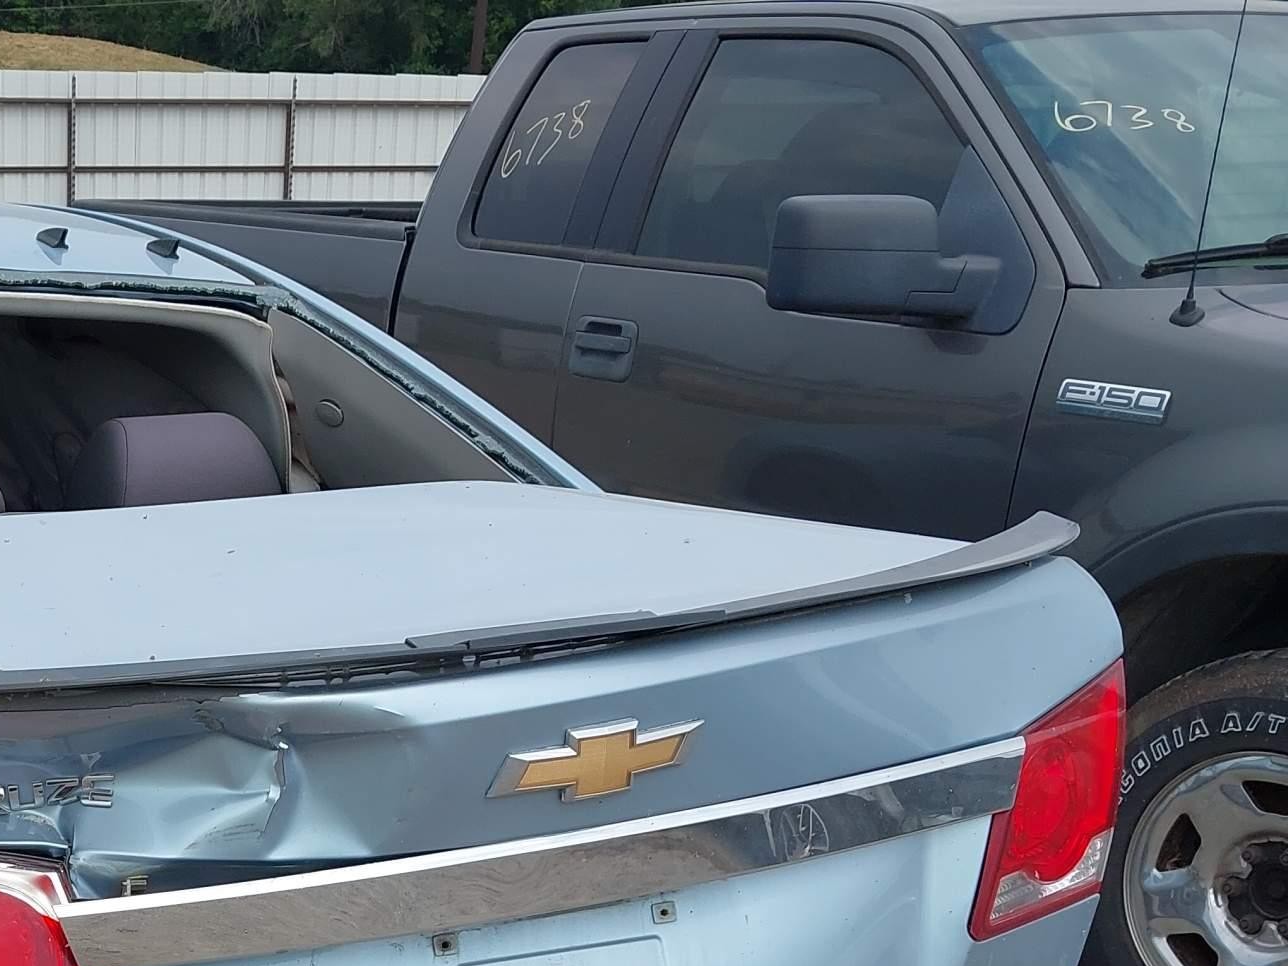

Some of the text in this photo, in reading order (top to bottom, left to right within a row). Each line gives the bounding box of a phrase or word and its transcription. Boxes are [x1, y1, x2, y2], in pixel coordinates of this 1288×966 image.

[501, 99, 591, 178] 6738
[1054, 100, 1195, 133] 6738
[1117, 711, 1286, 804] GONIA A/T
